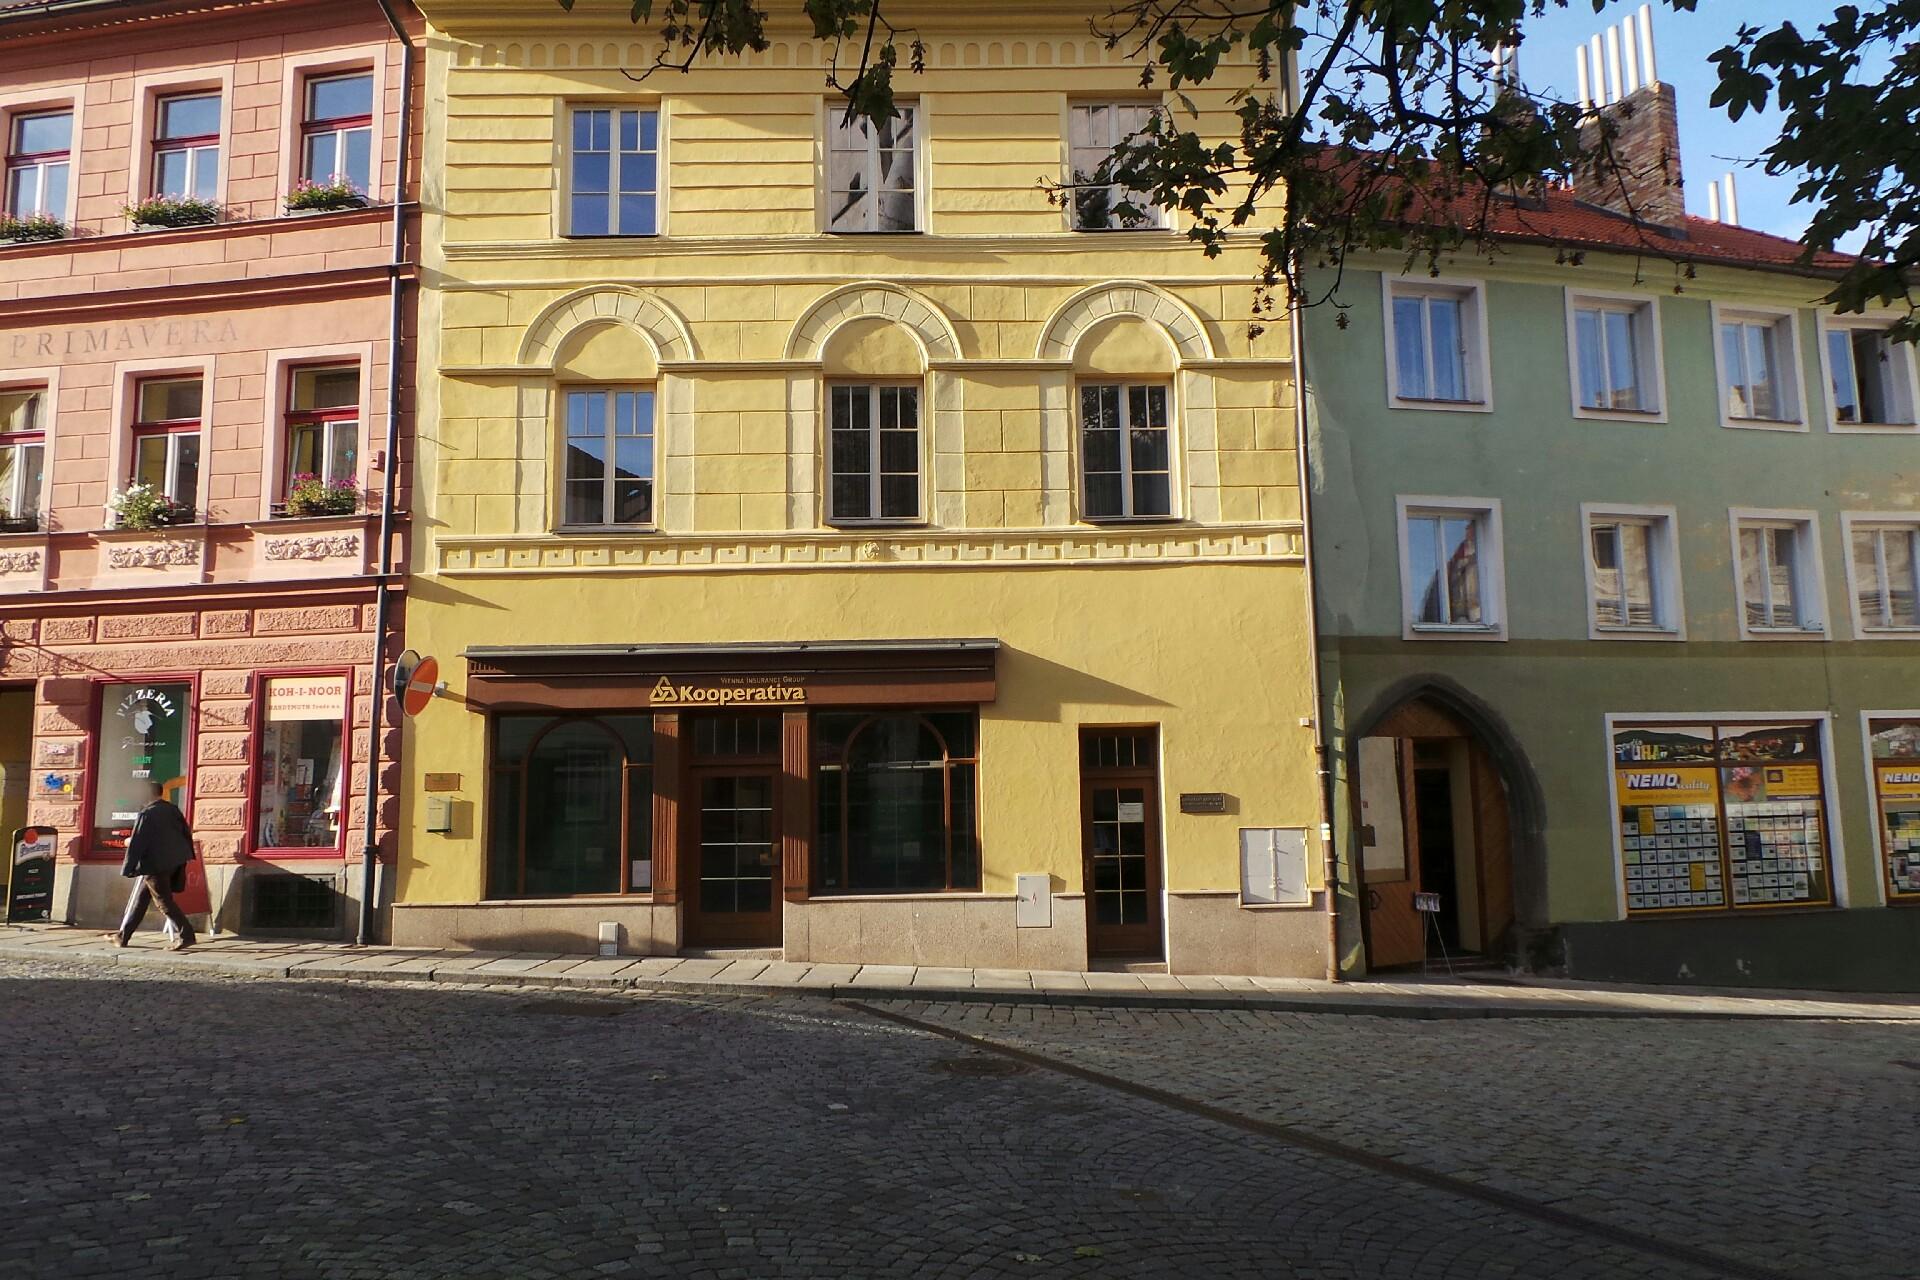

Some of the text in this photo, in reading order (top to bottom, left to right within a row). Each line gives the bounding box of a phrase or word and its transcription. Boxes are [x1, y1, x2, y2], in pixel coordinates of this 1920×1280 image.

[10, 317, 238, 358] PRIMAVERA
[269, 686, 342, 697] KOH-I-NOOR
[680, 684, 805, 706] Kooperativa
[116, 689, 176, 717] PIZZERIA
[1627, 773, 1679, 788] NEMO
[1885, 773, 1920, 784] NEMO
